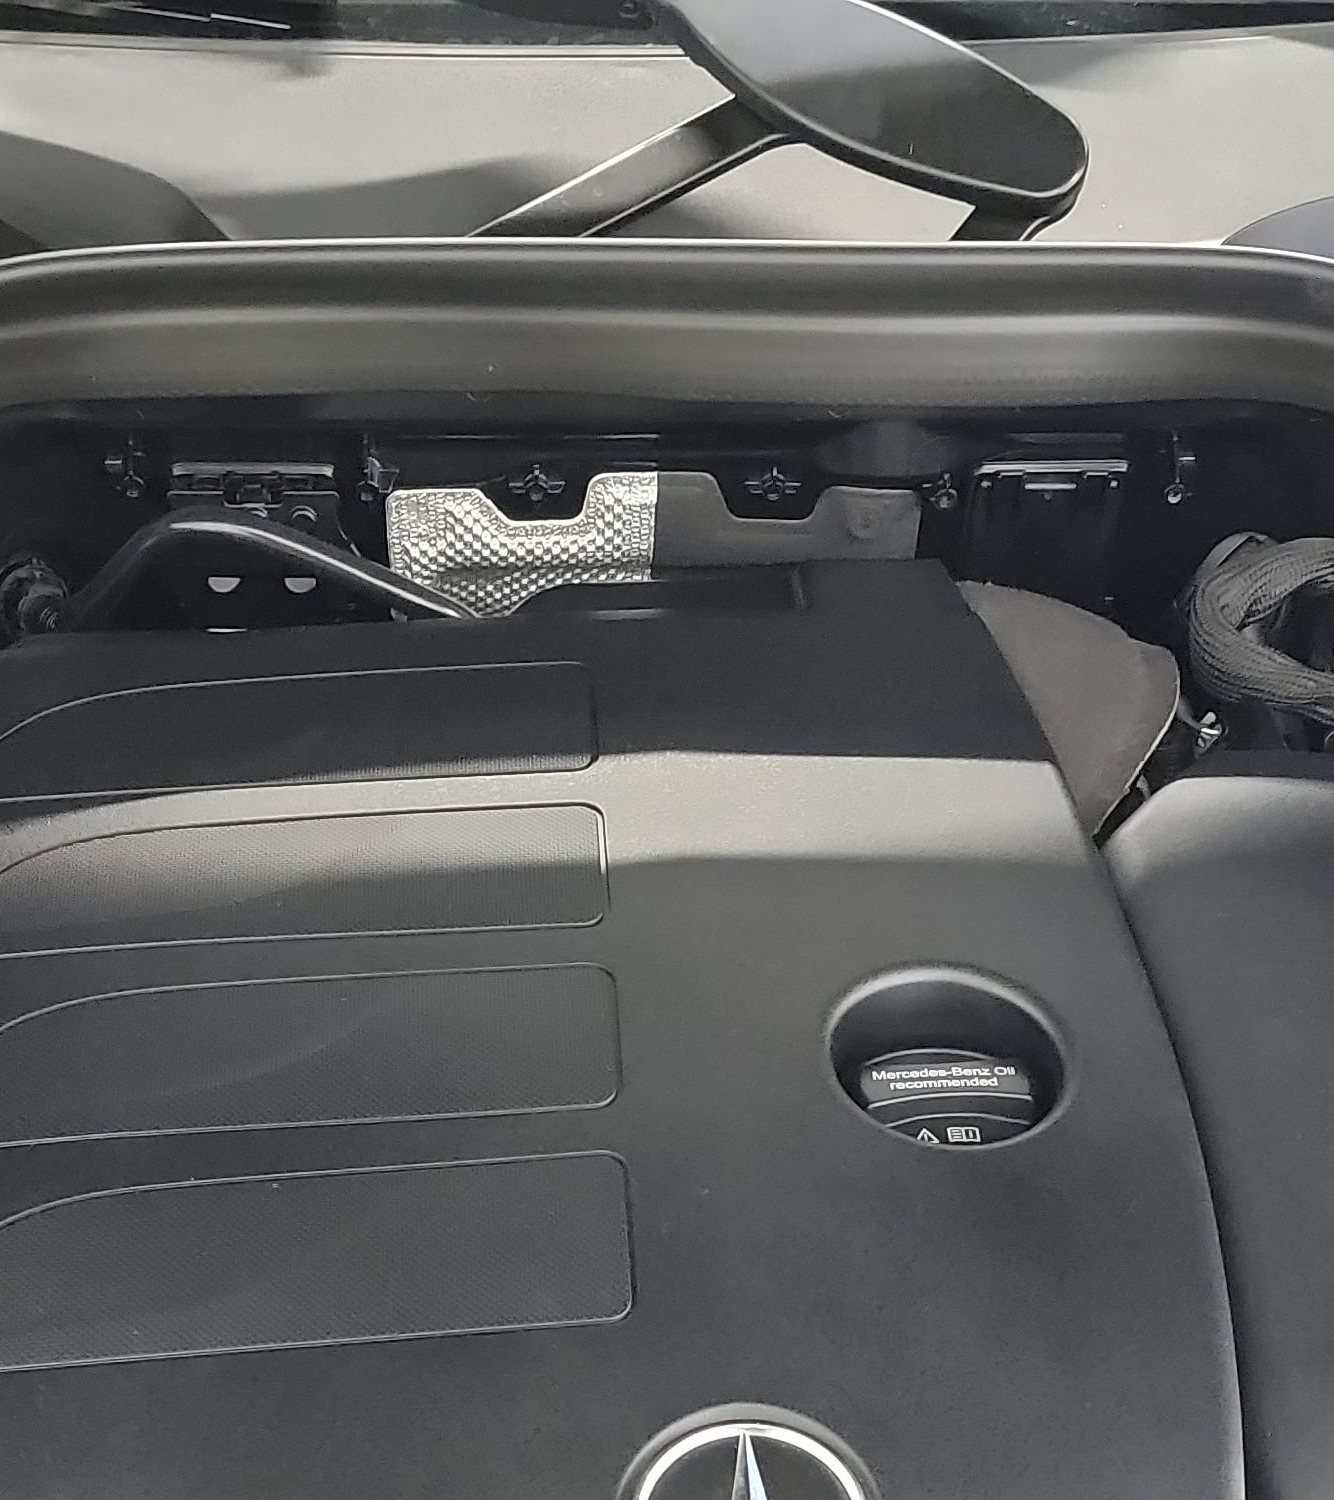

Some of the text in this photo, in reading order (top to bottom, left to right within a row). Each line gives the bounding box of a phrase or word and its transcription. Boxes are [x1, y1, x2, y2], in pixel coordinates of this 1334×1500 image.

[872, 1066, 1015, 1081] Mercedes-Benz Oil
[889, 1077, 999, 1091] recommended
